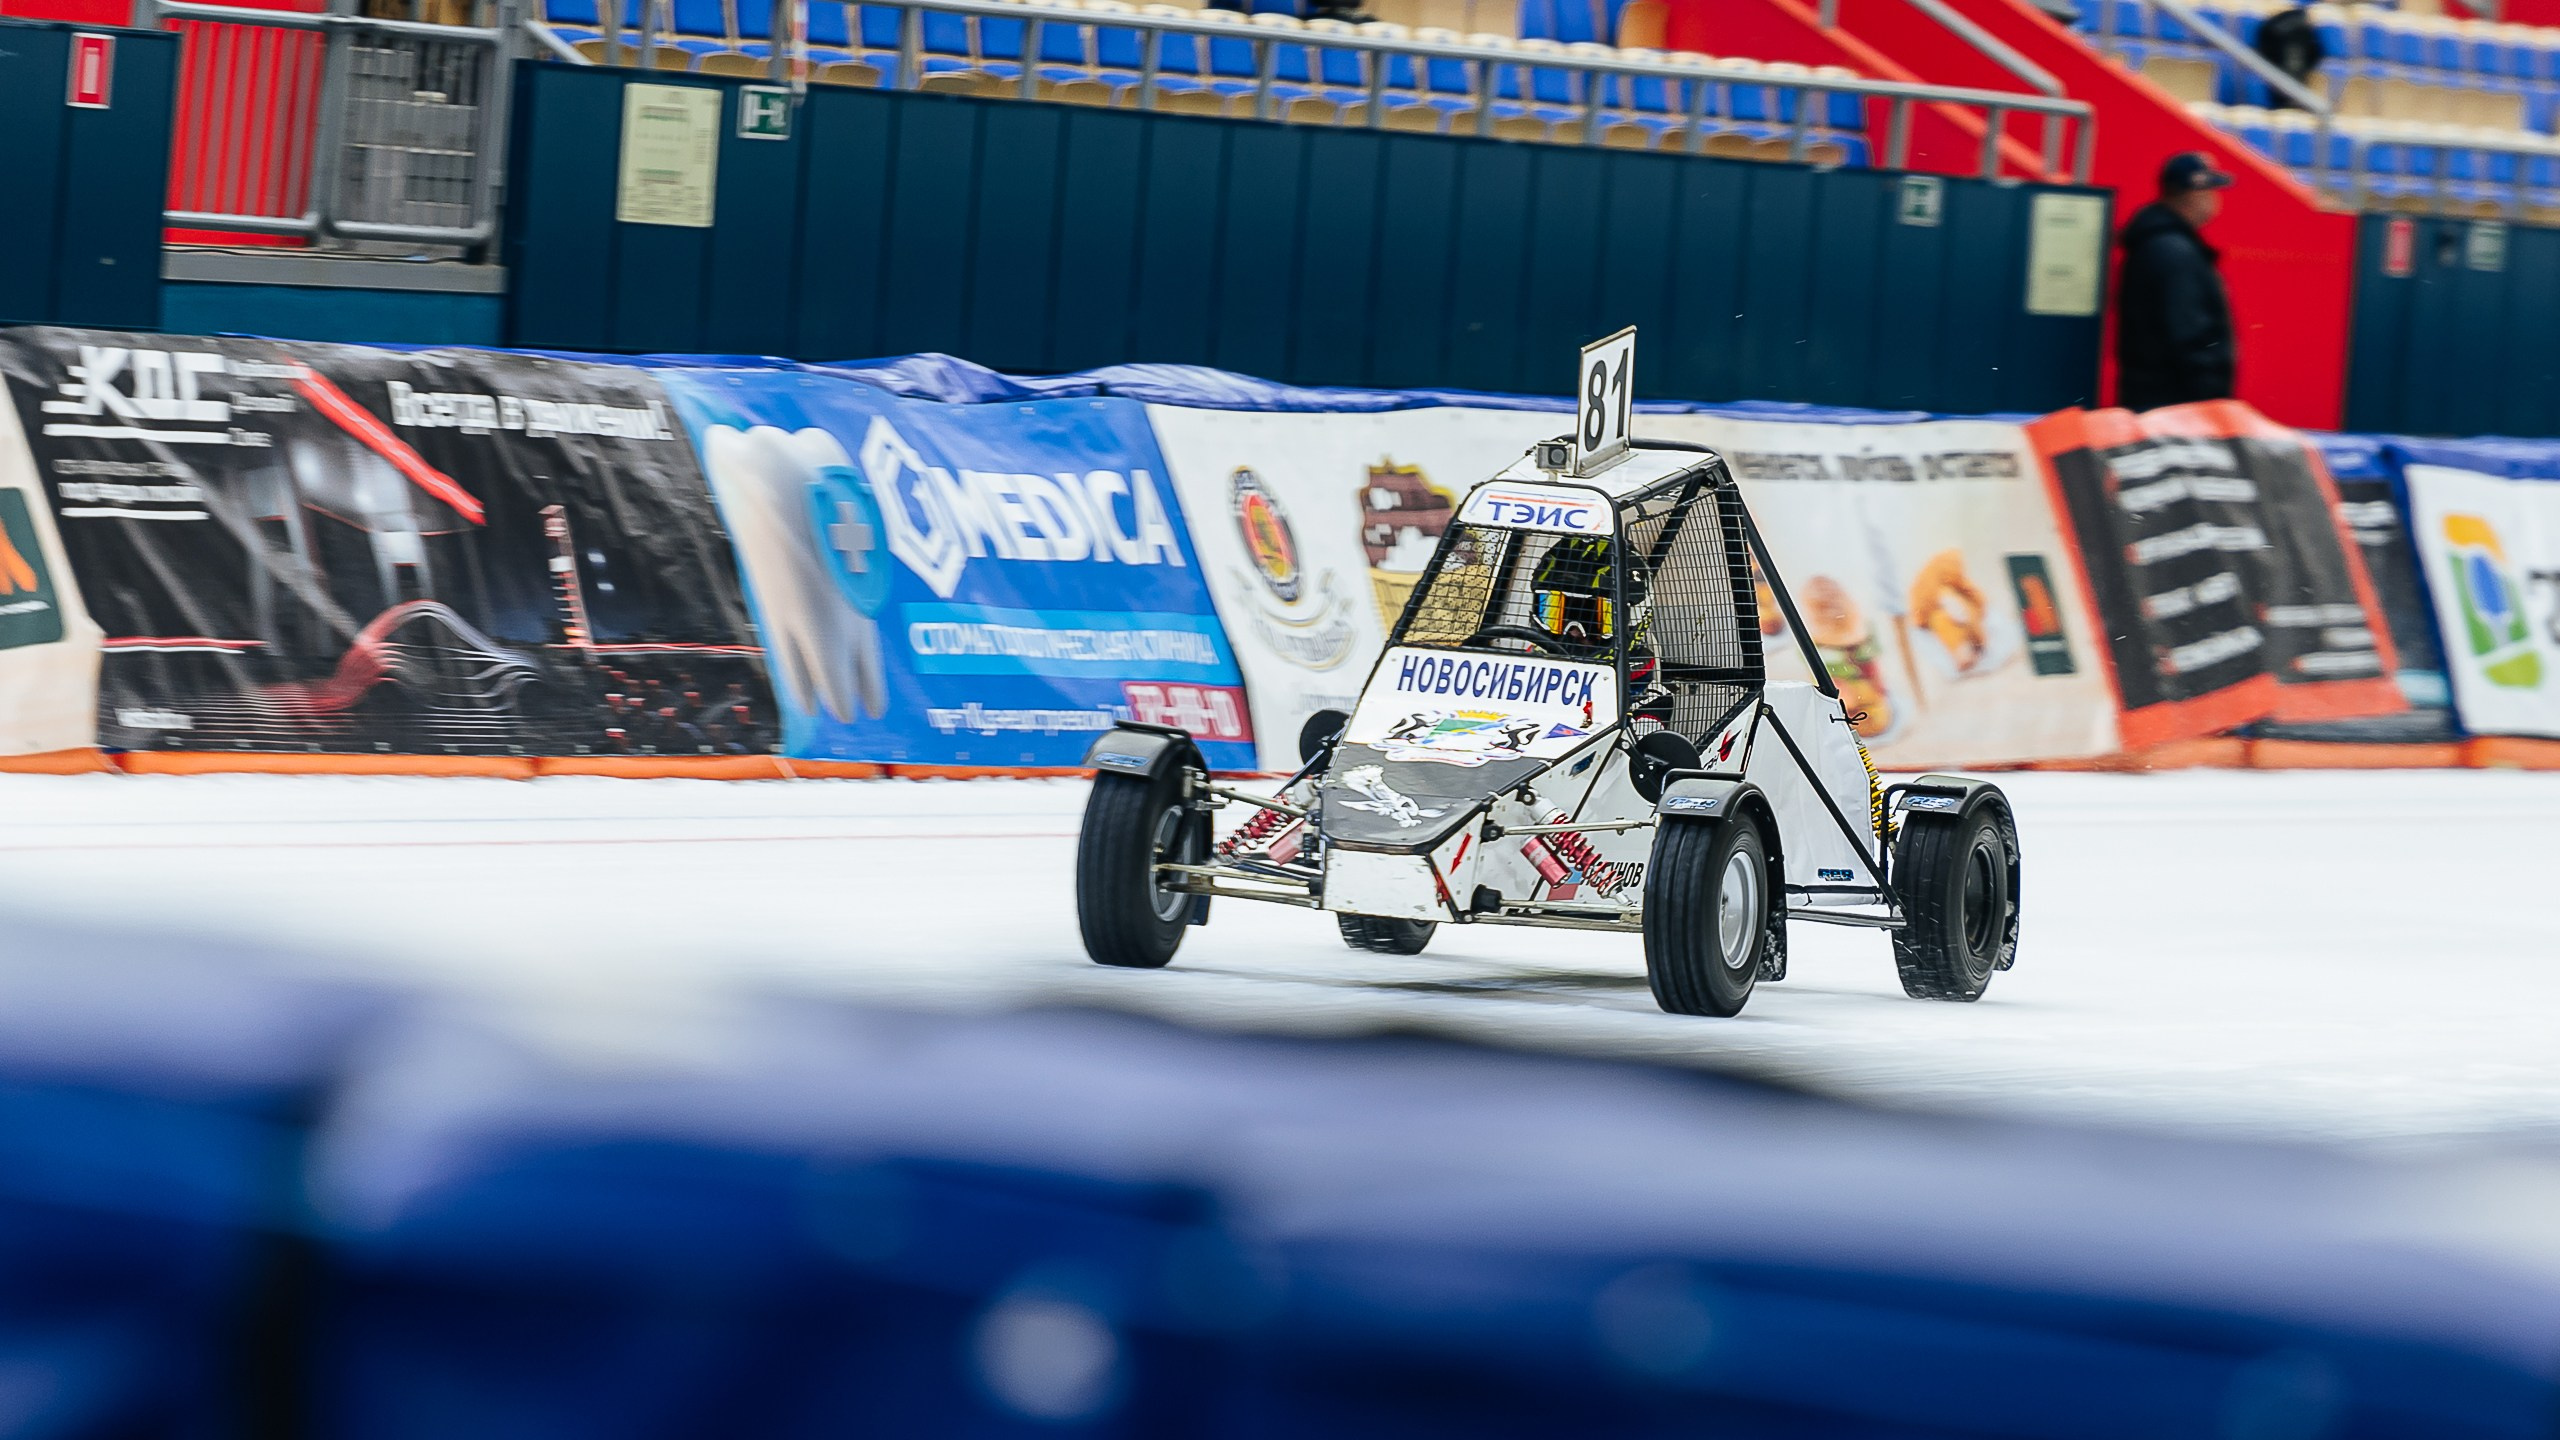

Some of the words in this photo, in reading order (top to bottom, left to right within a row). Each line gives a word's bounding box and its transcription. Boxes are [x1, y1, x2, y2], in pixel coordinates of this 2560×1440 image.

[1584, 347, 1629, 452] 81
[956, 468, 1187, 567] MEDICA
[1488, 501, 1589, 529] ТЭИС
[1397, 655, 1599, 707] НОВОСИБИРСК
